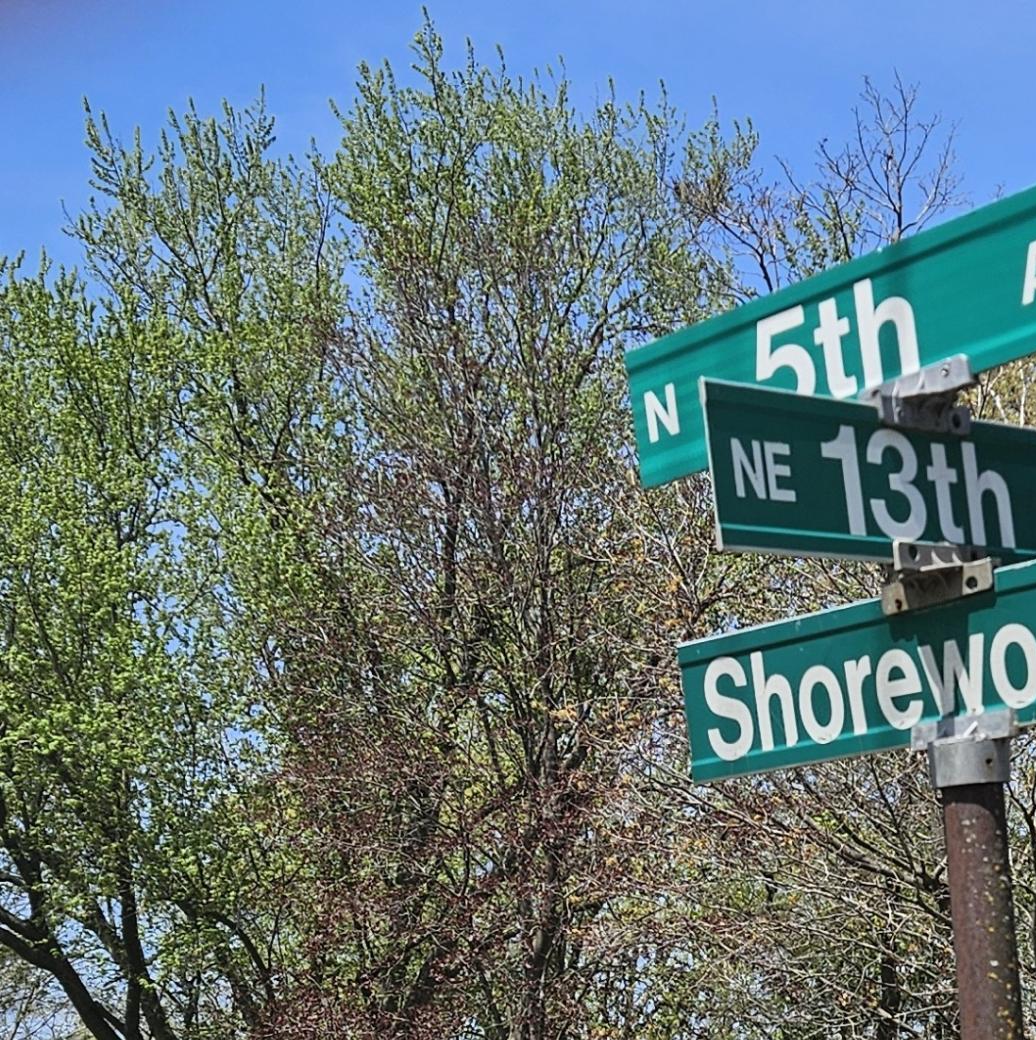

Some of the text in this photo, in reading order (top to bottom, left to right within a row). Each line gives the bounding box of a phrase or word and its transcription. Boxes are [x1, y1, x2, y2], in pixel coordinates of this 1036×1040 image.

[643, 383, 680, 443] N
[755, 278, 921, 399] 5th
[730, 438, 797, 502] NE
[820, 424, 1016, 549] 13th
